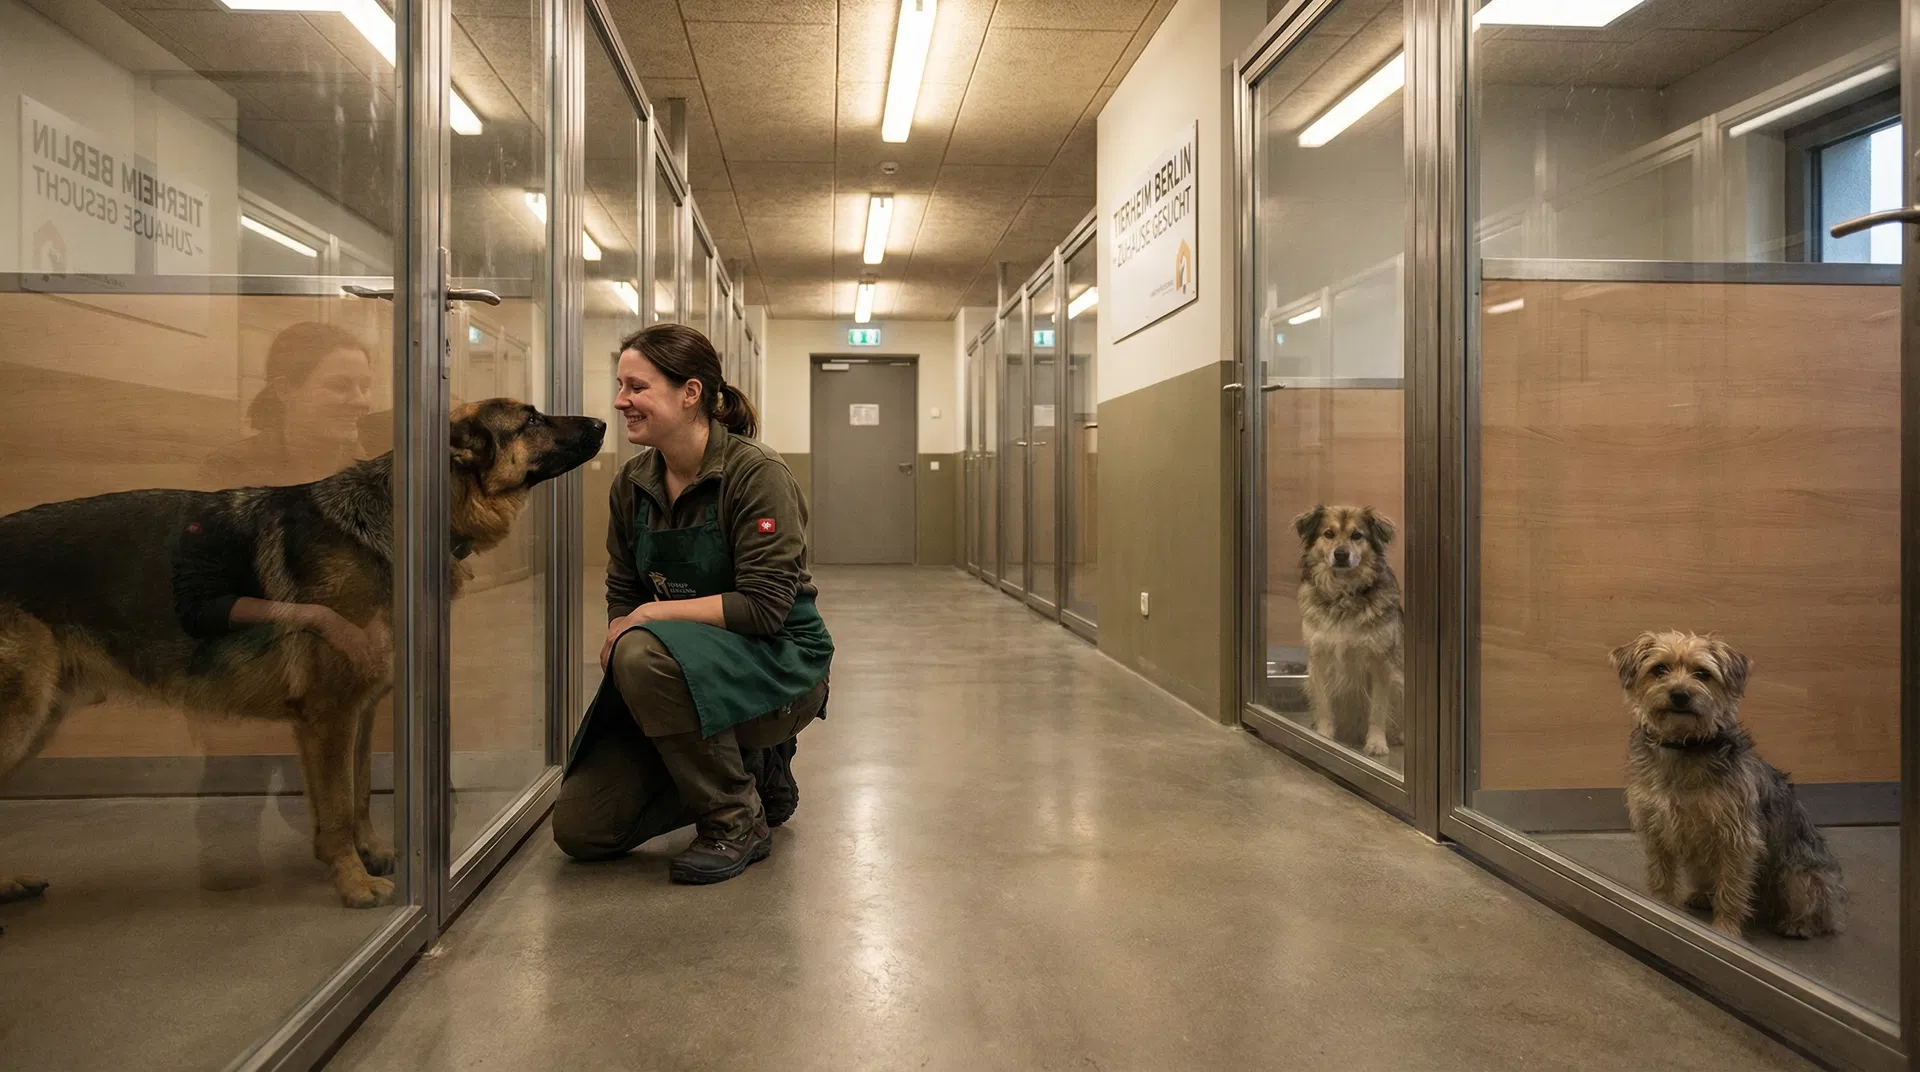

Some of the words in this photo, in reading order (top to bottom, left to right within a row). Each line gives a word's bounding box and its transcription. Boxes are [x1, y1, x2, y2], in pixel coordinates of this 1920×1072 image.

[1113, 179, 1152, 238] TIERHEIM
[1154, 142, 1192, 204] BERLIN
[1152, 185, 1192, 240] GESUCHT
